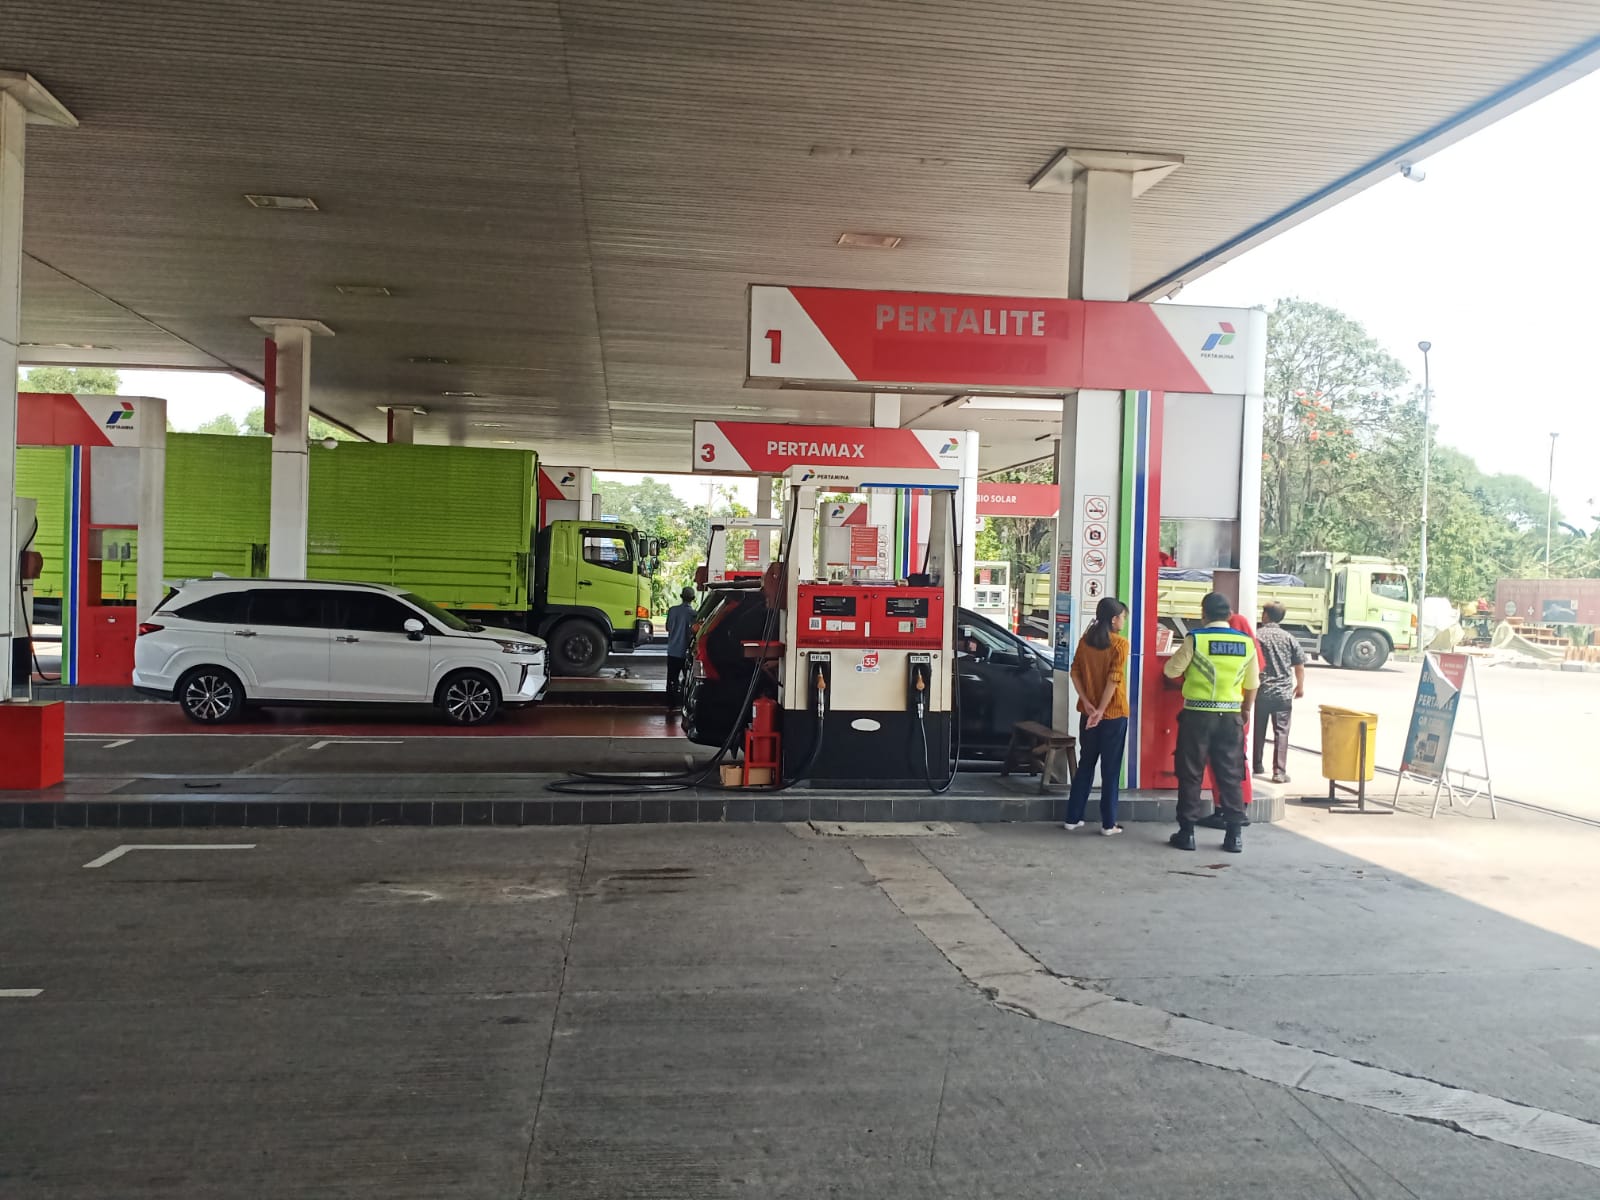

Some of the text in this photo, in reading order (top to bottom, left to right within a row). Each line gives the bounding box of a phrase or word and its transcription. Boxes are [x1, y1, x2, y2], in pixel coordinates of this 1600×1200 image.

[876, 304, 1046, 337] PERTALITE
[764, 329, 782, 364] 1
[700, 443, 716, 463] 3
[767, 441, 865, 459] PERTAMAX
[991, 495, 1017, 504] SOLAR
[1210, 641, 1246, 655] SATPAM
